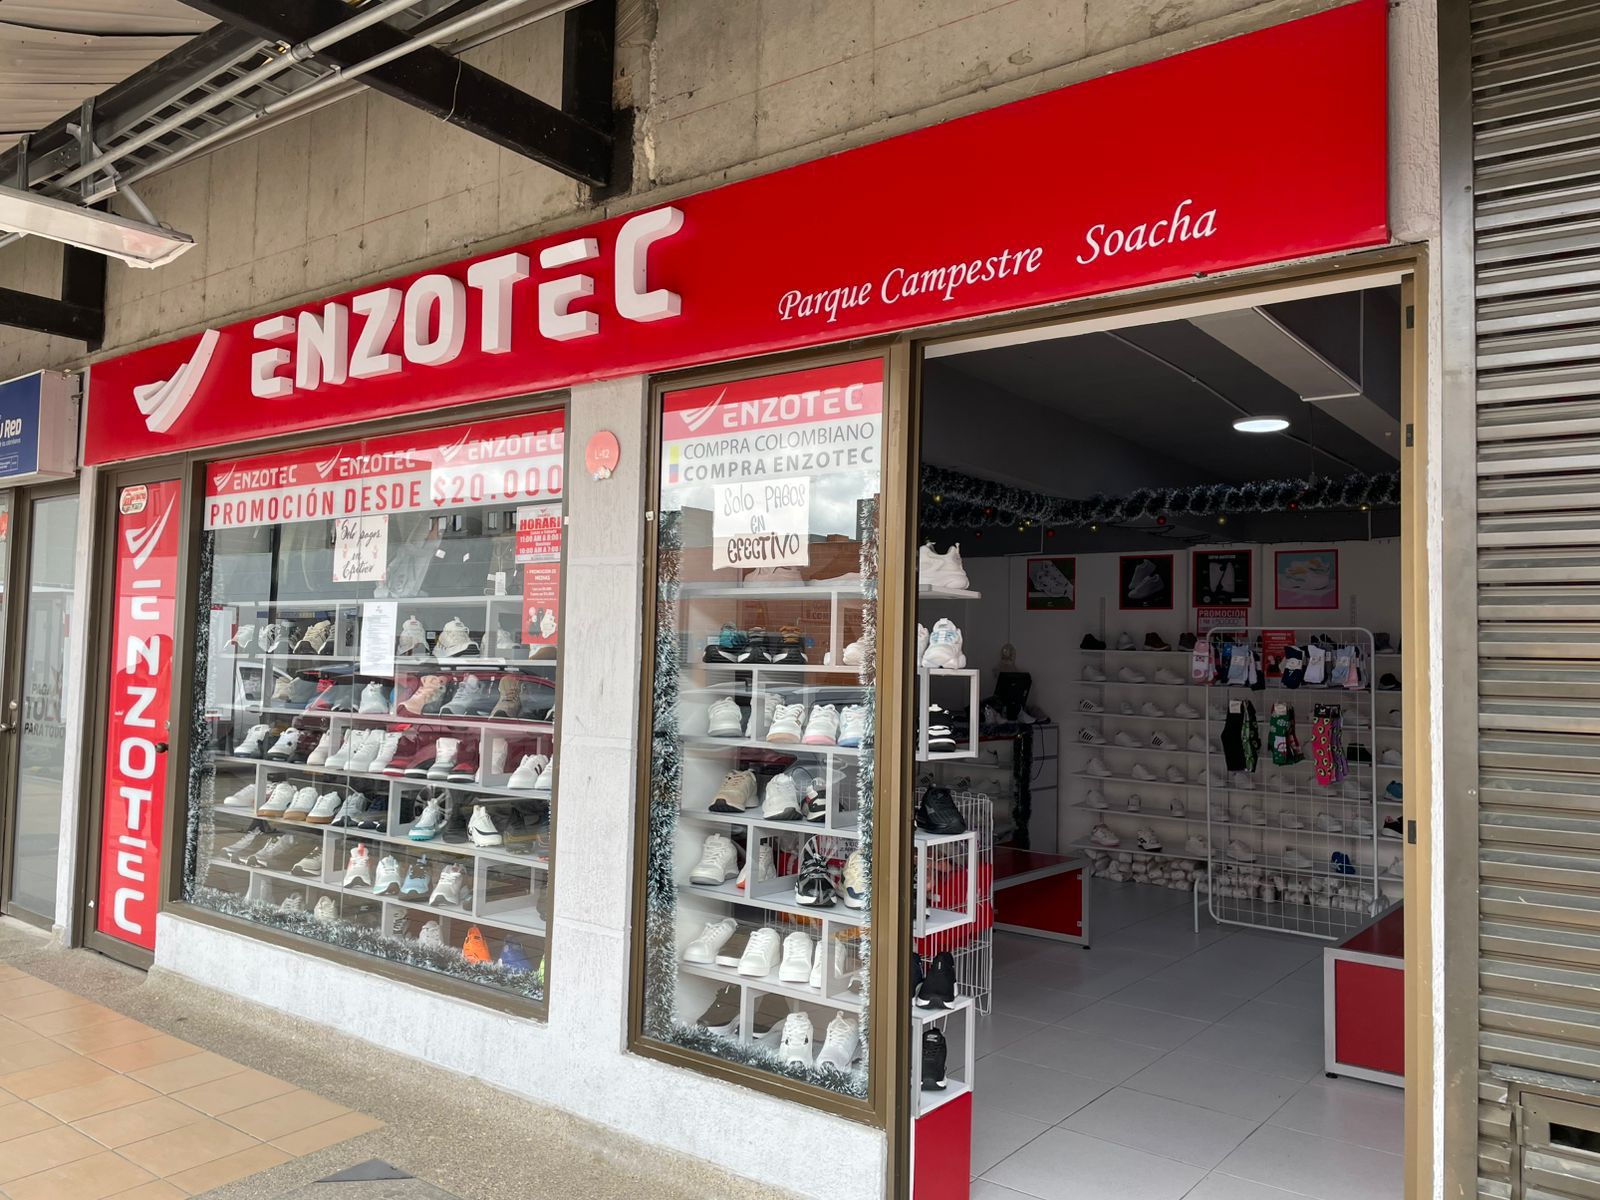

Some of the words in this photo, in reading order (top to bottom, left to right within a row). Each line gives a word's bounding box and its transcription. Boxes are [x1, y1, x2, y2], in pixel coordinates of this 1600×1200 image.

[778, 282, 873, 323] Parque
[880, 246, 1043, 301] Campestre
[1076, 198, 1218, 265] Soacha
[250, 206, 685, 400] ENZOTEC
[722, 383, 864, 428] ENZOTEC
[468, 427, 563, 462] ENZOTEC
[683, 438, 751, 460] COMPRA
[754, 421, 875, 452] COLOMBIANO
[232, 464, 298, 492] ENZOTEC
[339, 448, 416, 477] ENZOTEC
[683, 459, 767, 482] COMPRA
[773, 446, 874, 473] ENZOTEC
[210, 487, 335, 527] PROMOCIÓN
[344, 480, 422, 514] DESDE
[434, 464, 563, 507] $20.000
[723, 485, 754, 516] Solo
[113, 579, 161, 936] ENZOTEC
